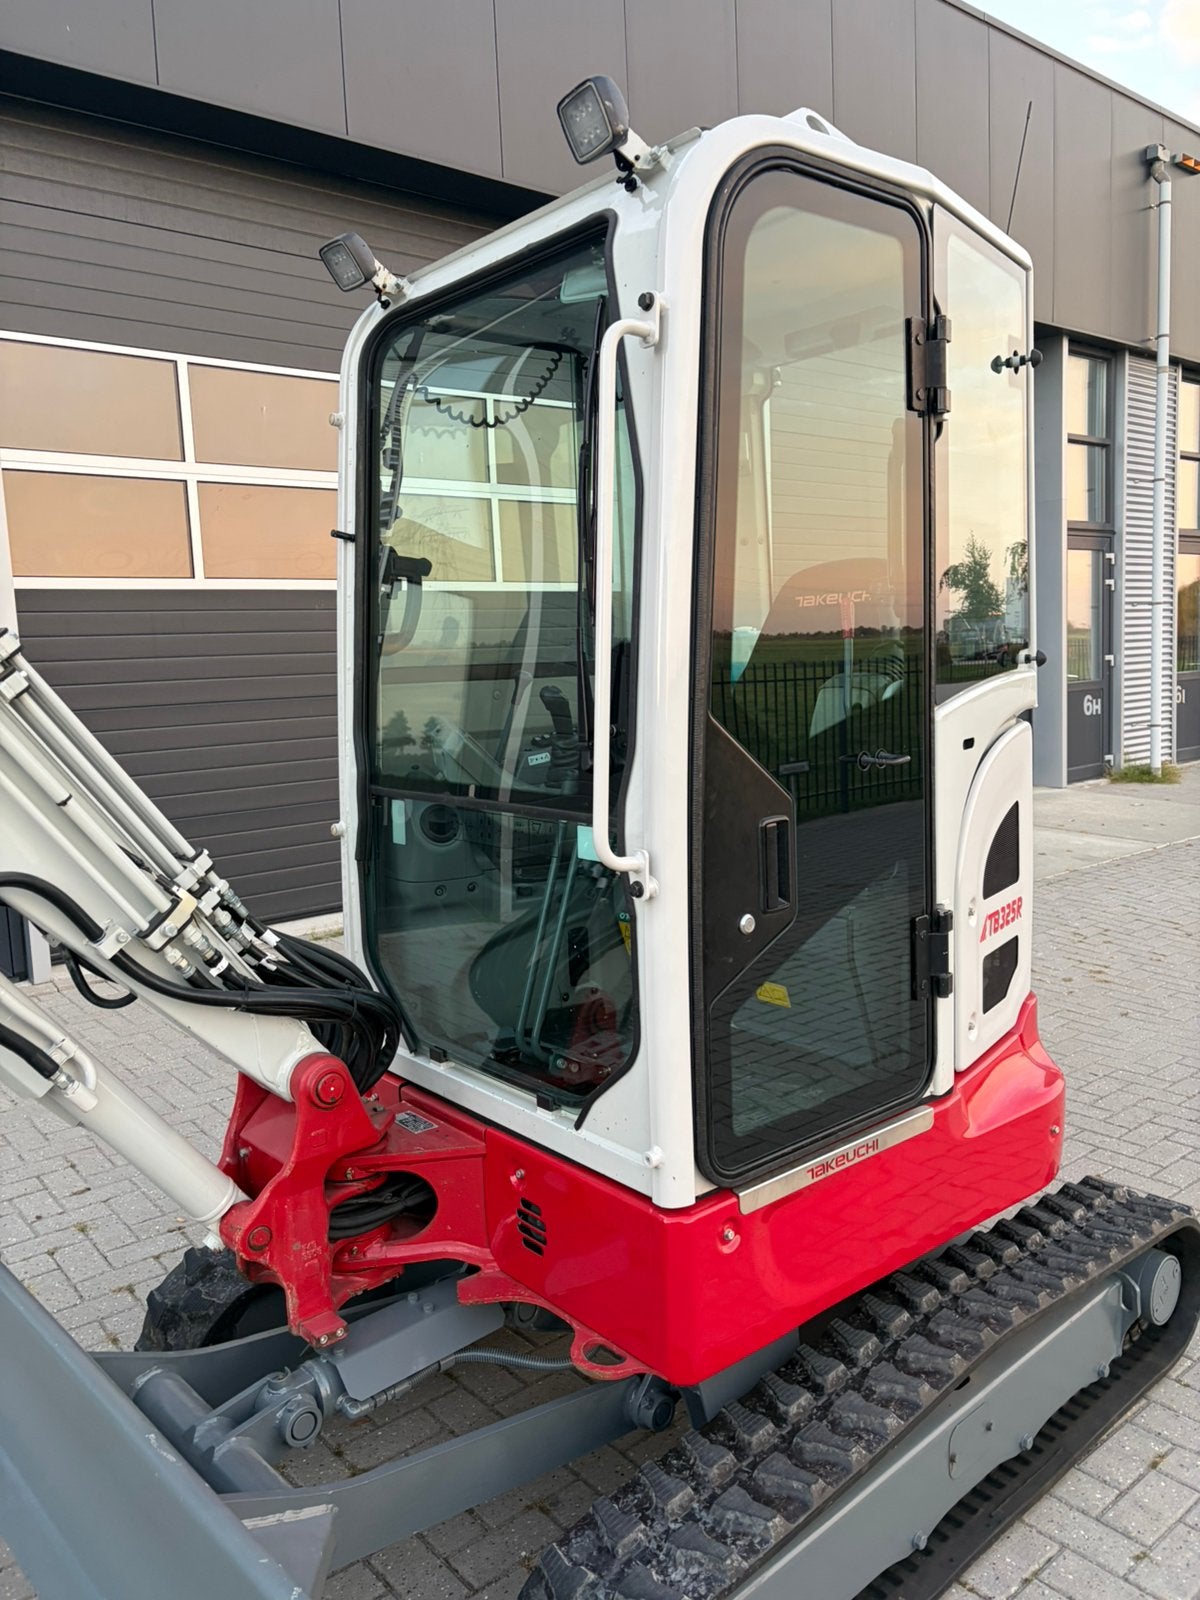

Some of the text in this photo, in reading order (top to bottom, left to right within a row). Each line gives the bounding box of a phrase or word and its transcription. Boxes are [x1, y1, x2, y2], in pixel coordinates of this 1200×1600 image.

[795, 590, 872, 607] TAKEUCH
[1083, 694, 1102, 716] 6H
[982, 896, 1023, 940] TB325R
[806, 1138, 879, 1180] TAKEUCHI
